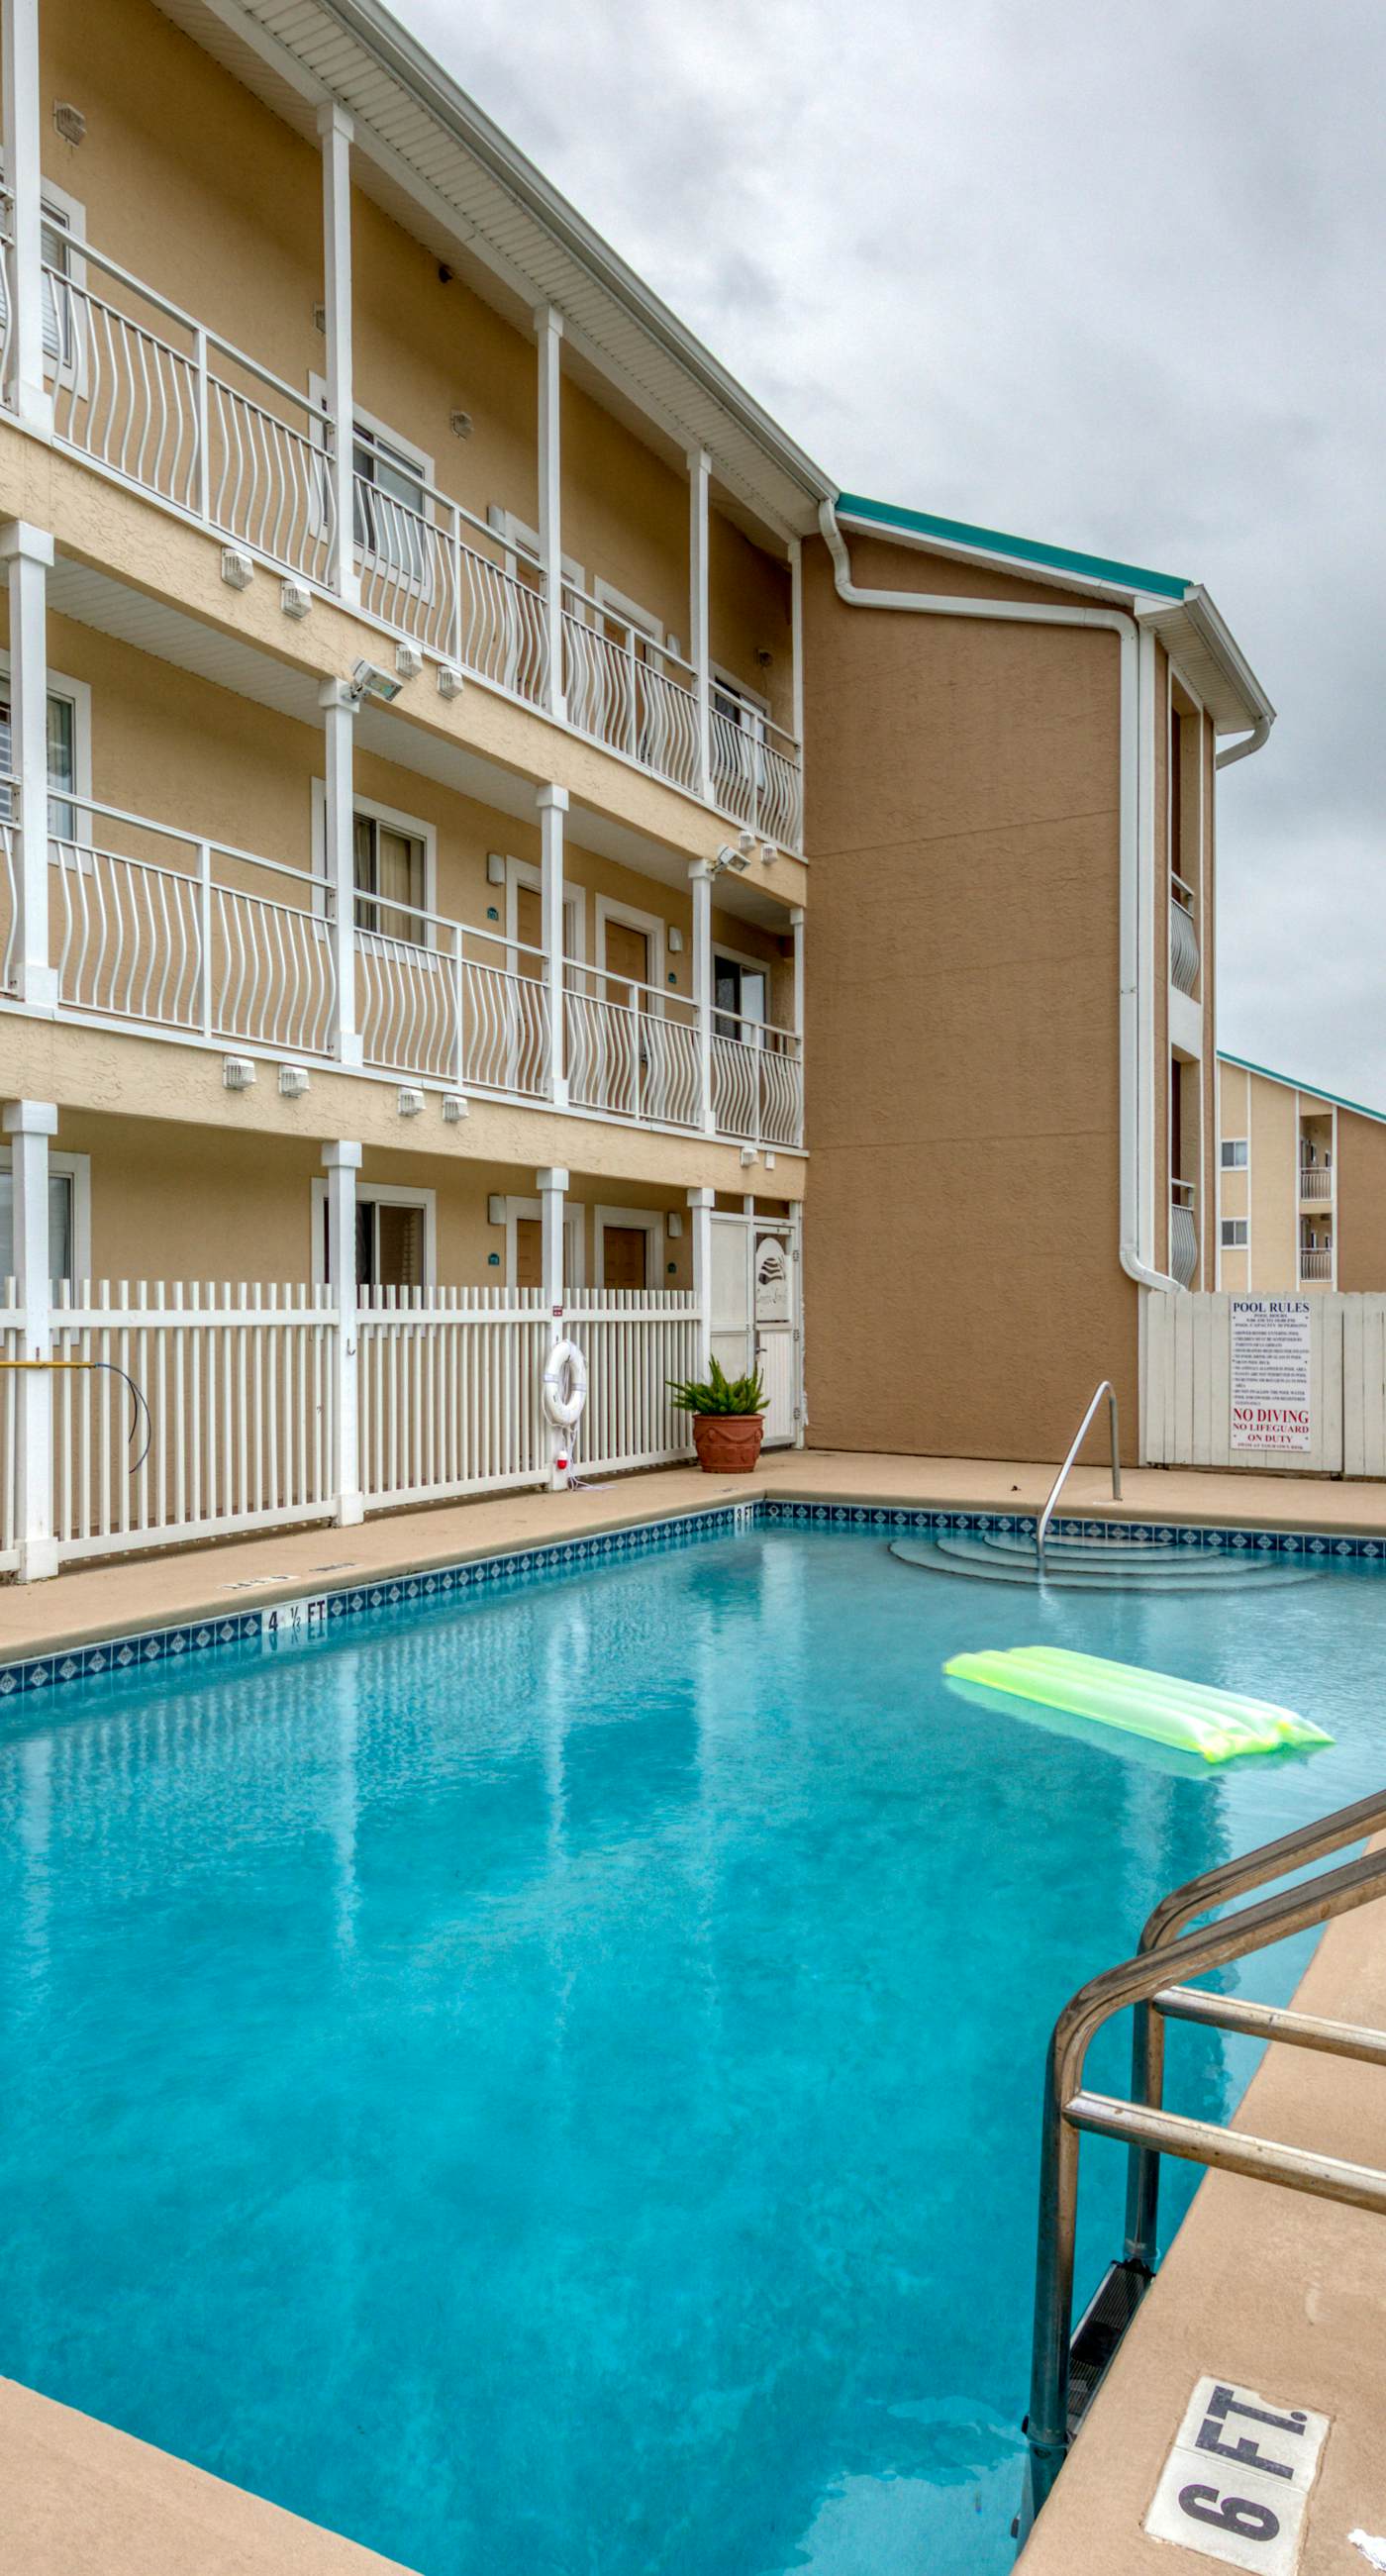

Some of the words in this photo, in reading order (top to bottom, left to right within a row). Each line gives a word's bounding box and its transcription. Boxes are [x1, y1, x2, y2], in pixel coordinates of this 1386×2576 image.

[1234, 1302, 1266, 1313] POOL
[1269, 1302, 1310, 1313] RULES
[1234, 1408, 1253, 1422] NO
[1257, 1409, 1309, 1424] DIVING
[1249, 1424, 1309, 1434] LIFEGUARD
[1265, 1435, 1292, 1443] DUTY
[737, 1508, 742, 1521] 3
[268, 1611, 278, 1632] 4
[1195, 2385, 1307, 2480] FT.
[1178, 2483, 1280, 2542] 6
